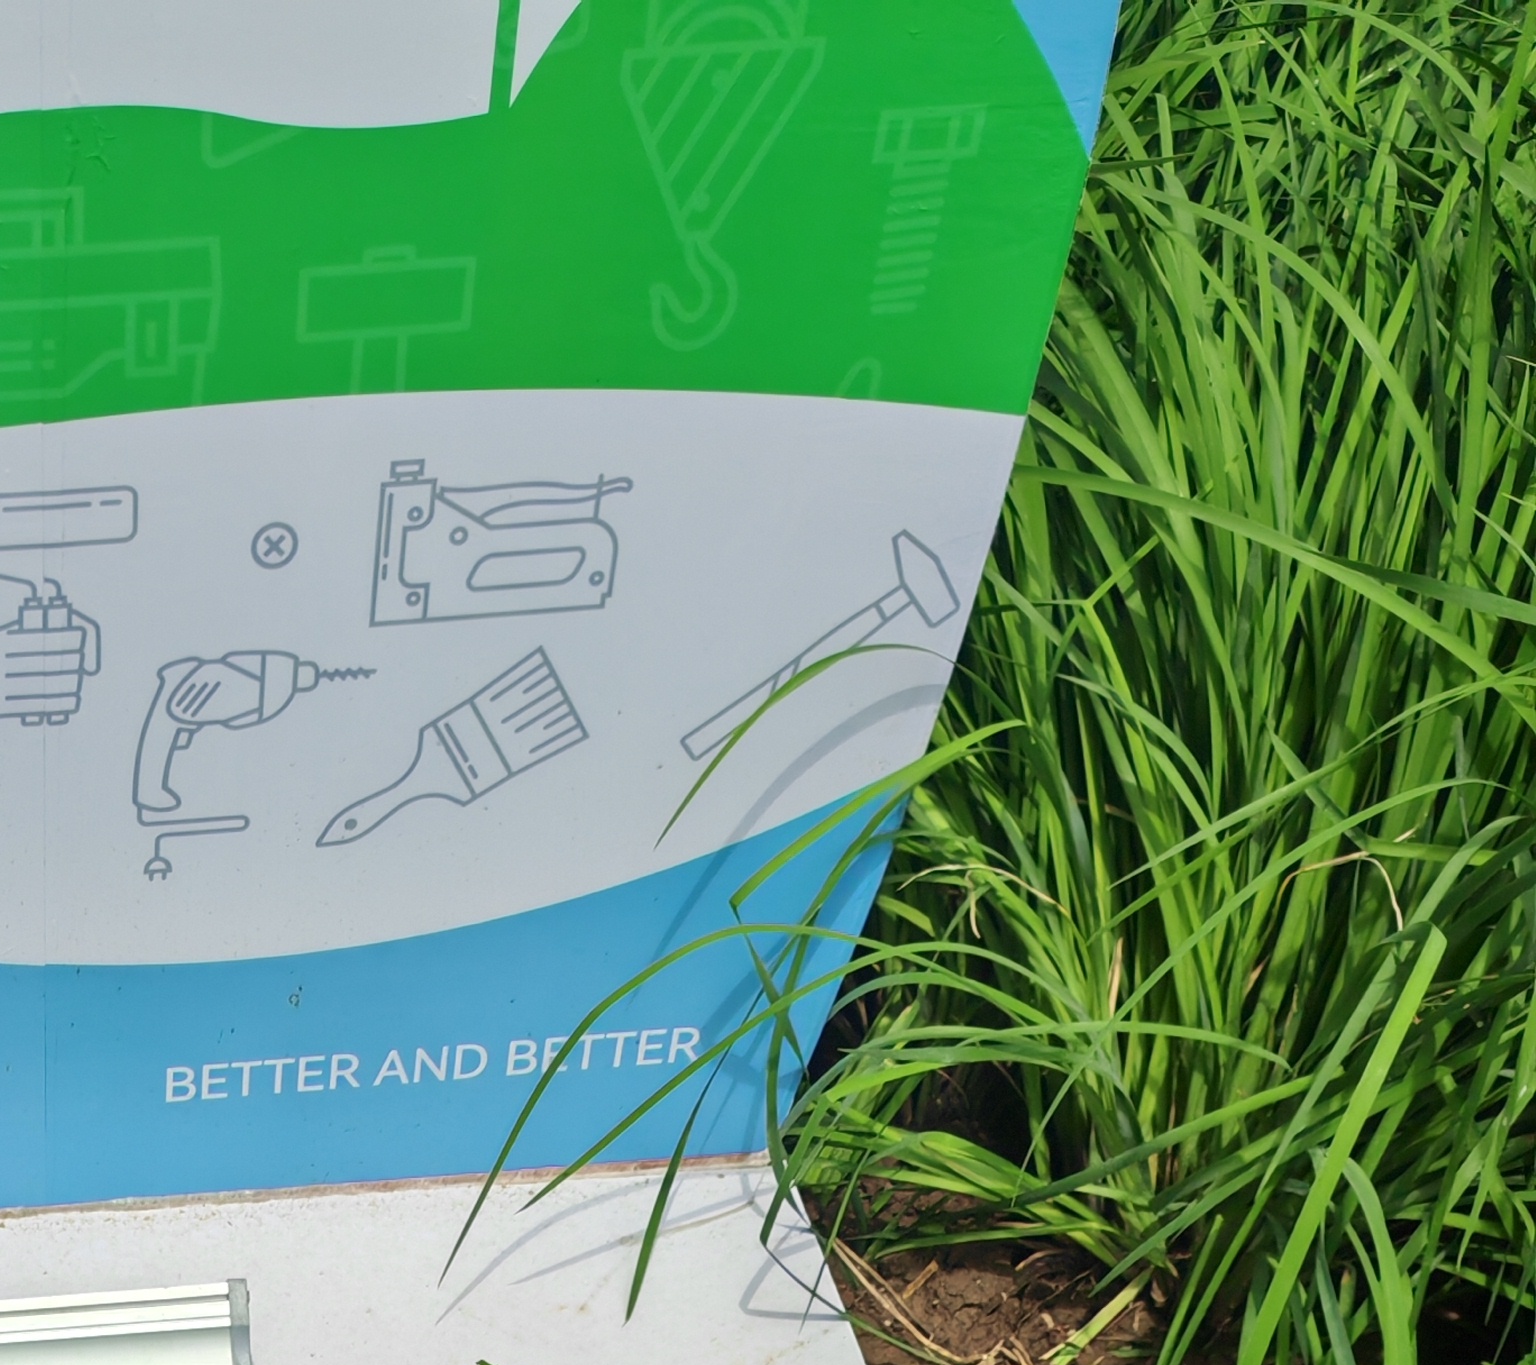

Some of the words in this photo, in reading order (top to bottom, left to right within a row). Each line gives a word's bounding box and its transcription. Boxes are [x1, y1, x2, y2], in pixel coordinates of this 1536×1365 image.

[165, 1053, 360, 1102] BETTER
[373, 1044, 488, 1087] AND
[505, 1027, 702, 1076] BETTER
